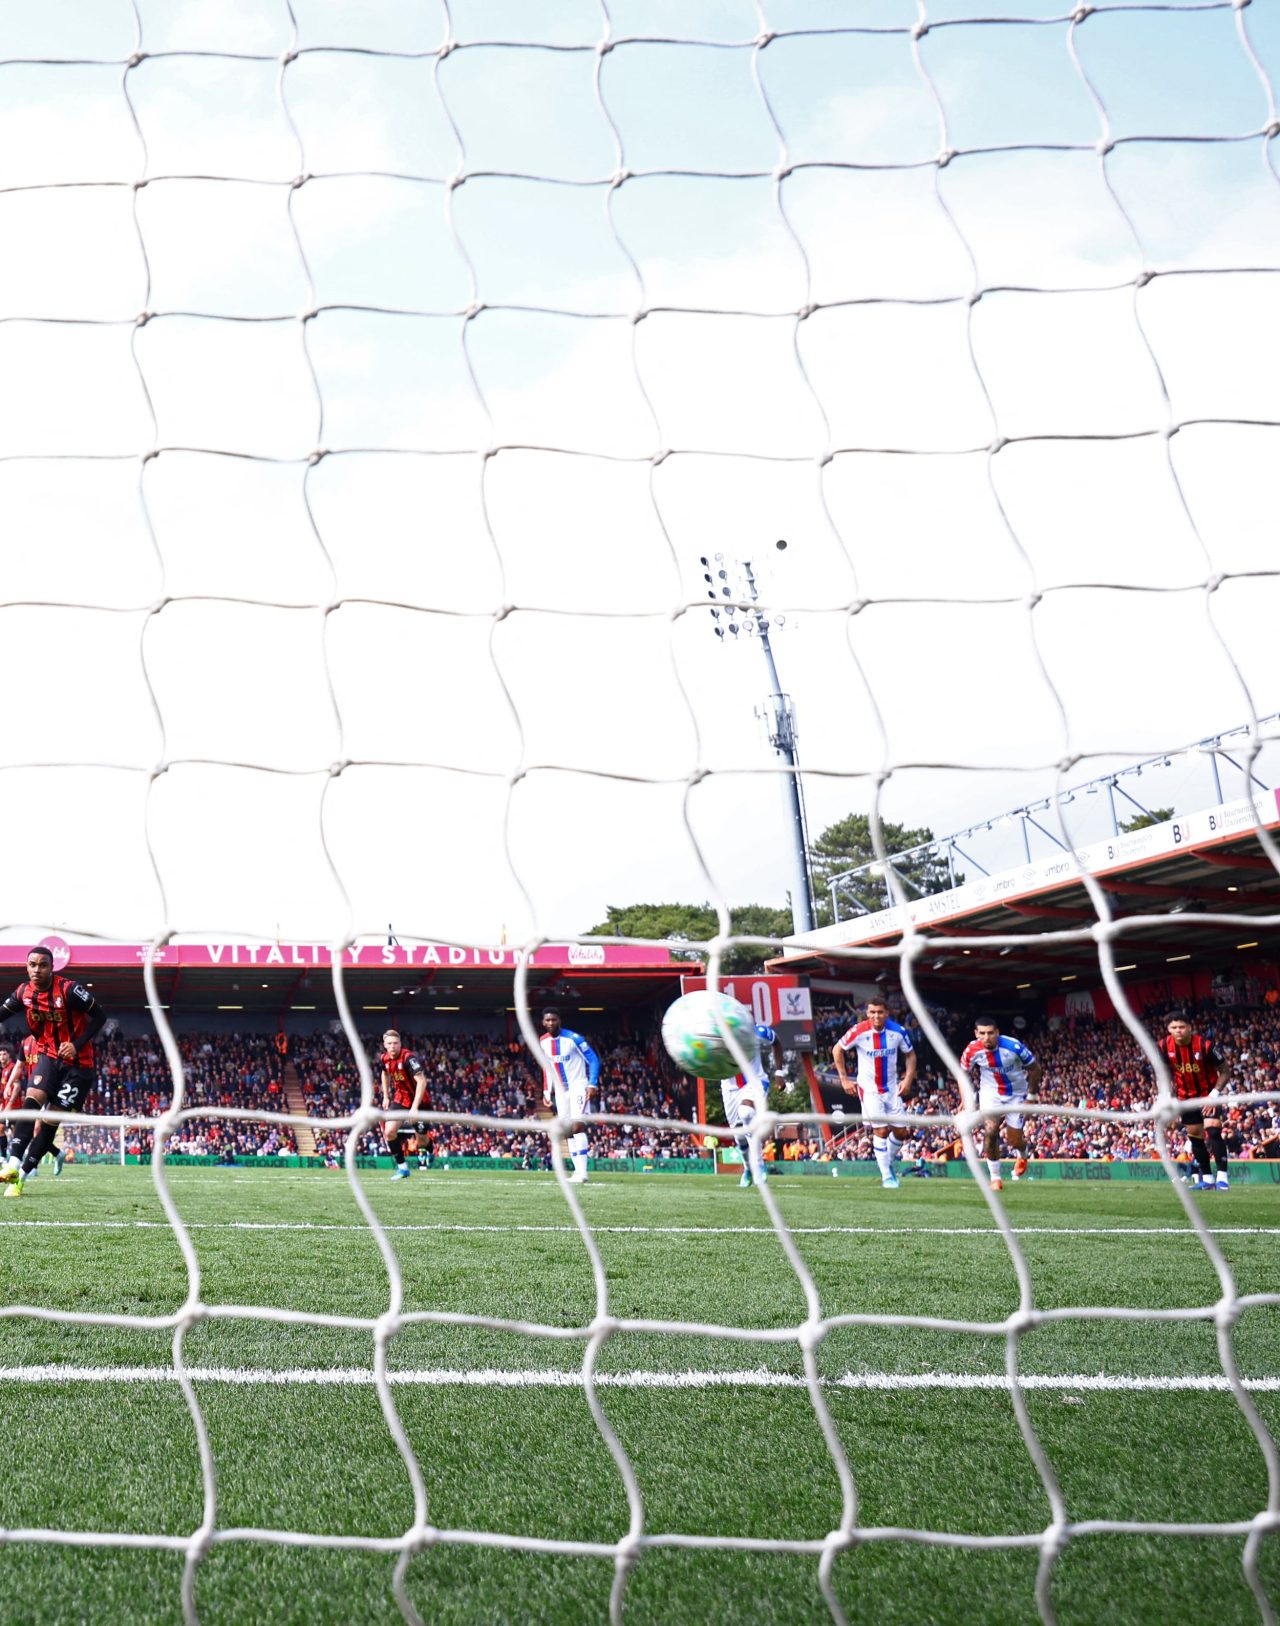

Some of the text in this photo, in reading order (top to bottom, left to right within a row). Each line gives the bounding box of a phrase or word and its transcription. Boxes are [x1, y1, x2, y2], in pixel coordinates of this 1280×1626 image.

[929, 893, 961, 914] AMSTEL
[57, 1083, 79, 1104] 22
[1084, 1162, 1112, 1180] Eats
